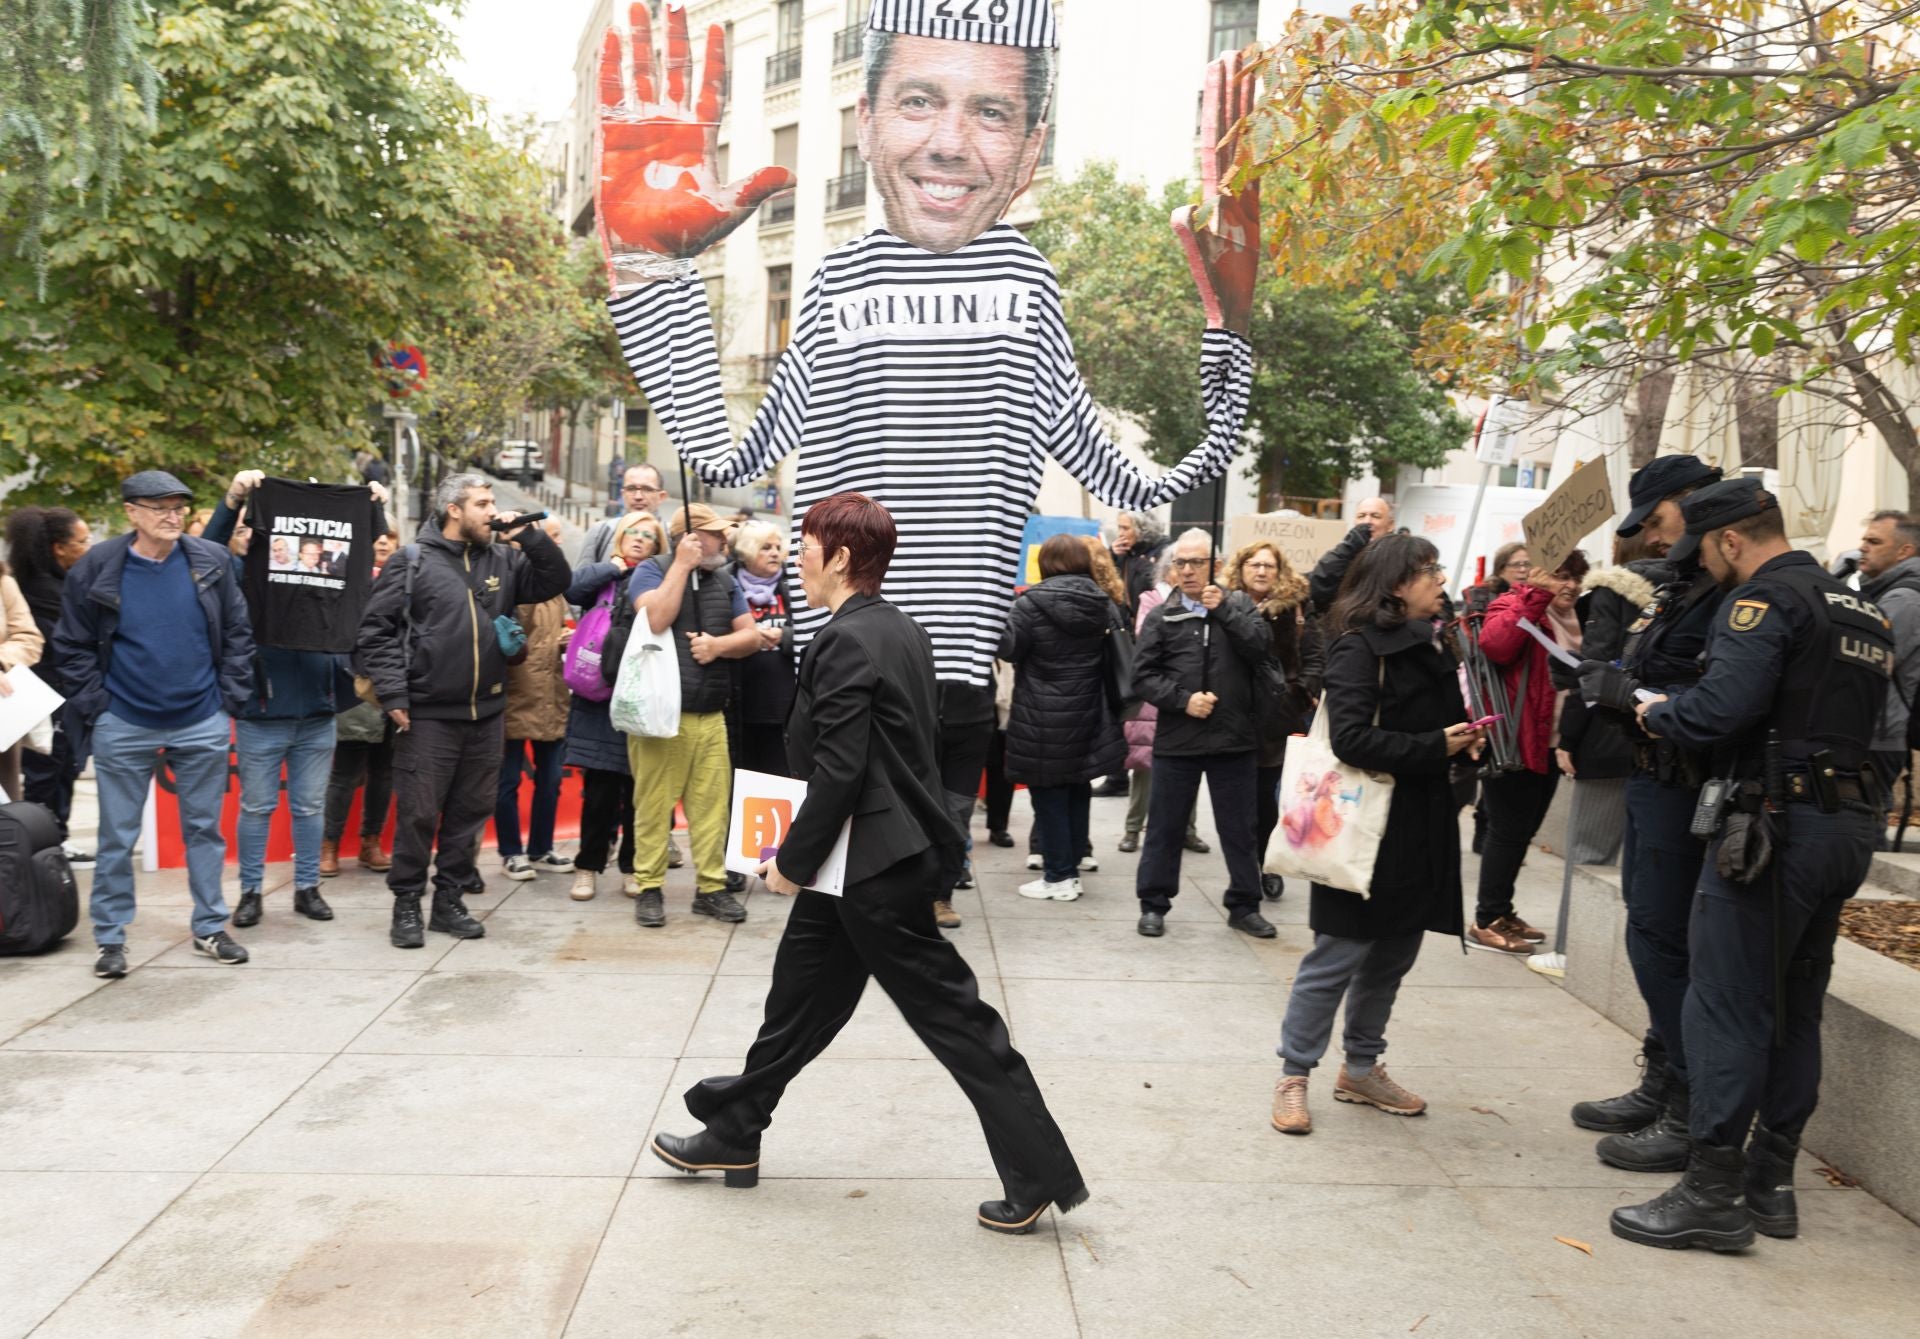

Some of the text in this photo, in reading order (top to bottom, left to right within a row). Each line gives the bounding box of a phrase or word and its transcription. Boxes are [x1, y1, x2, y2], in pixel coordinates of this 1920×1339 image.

[839, 293, 1022, 332] CRIMINAL
[271, 516, 353, 539] JUSTICIA
[1253, 521, 1316, 540] MAZON
